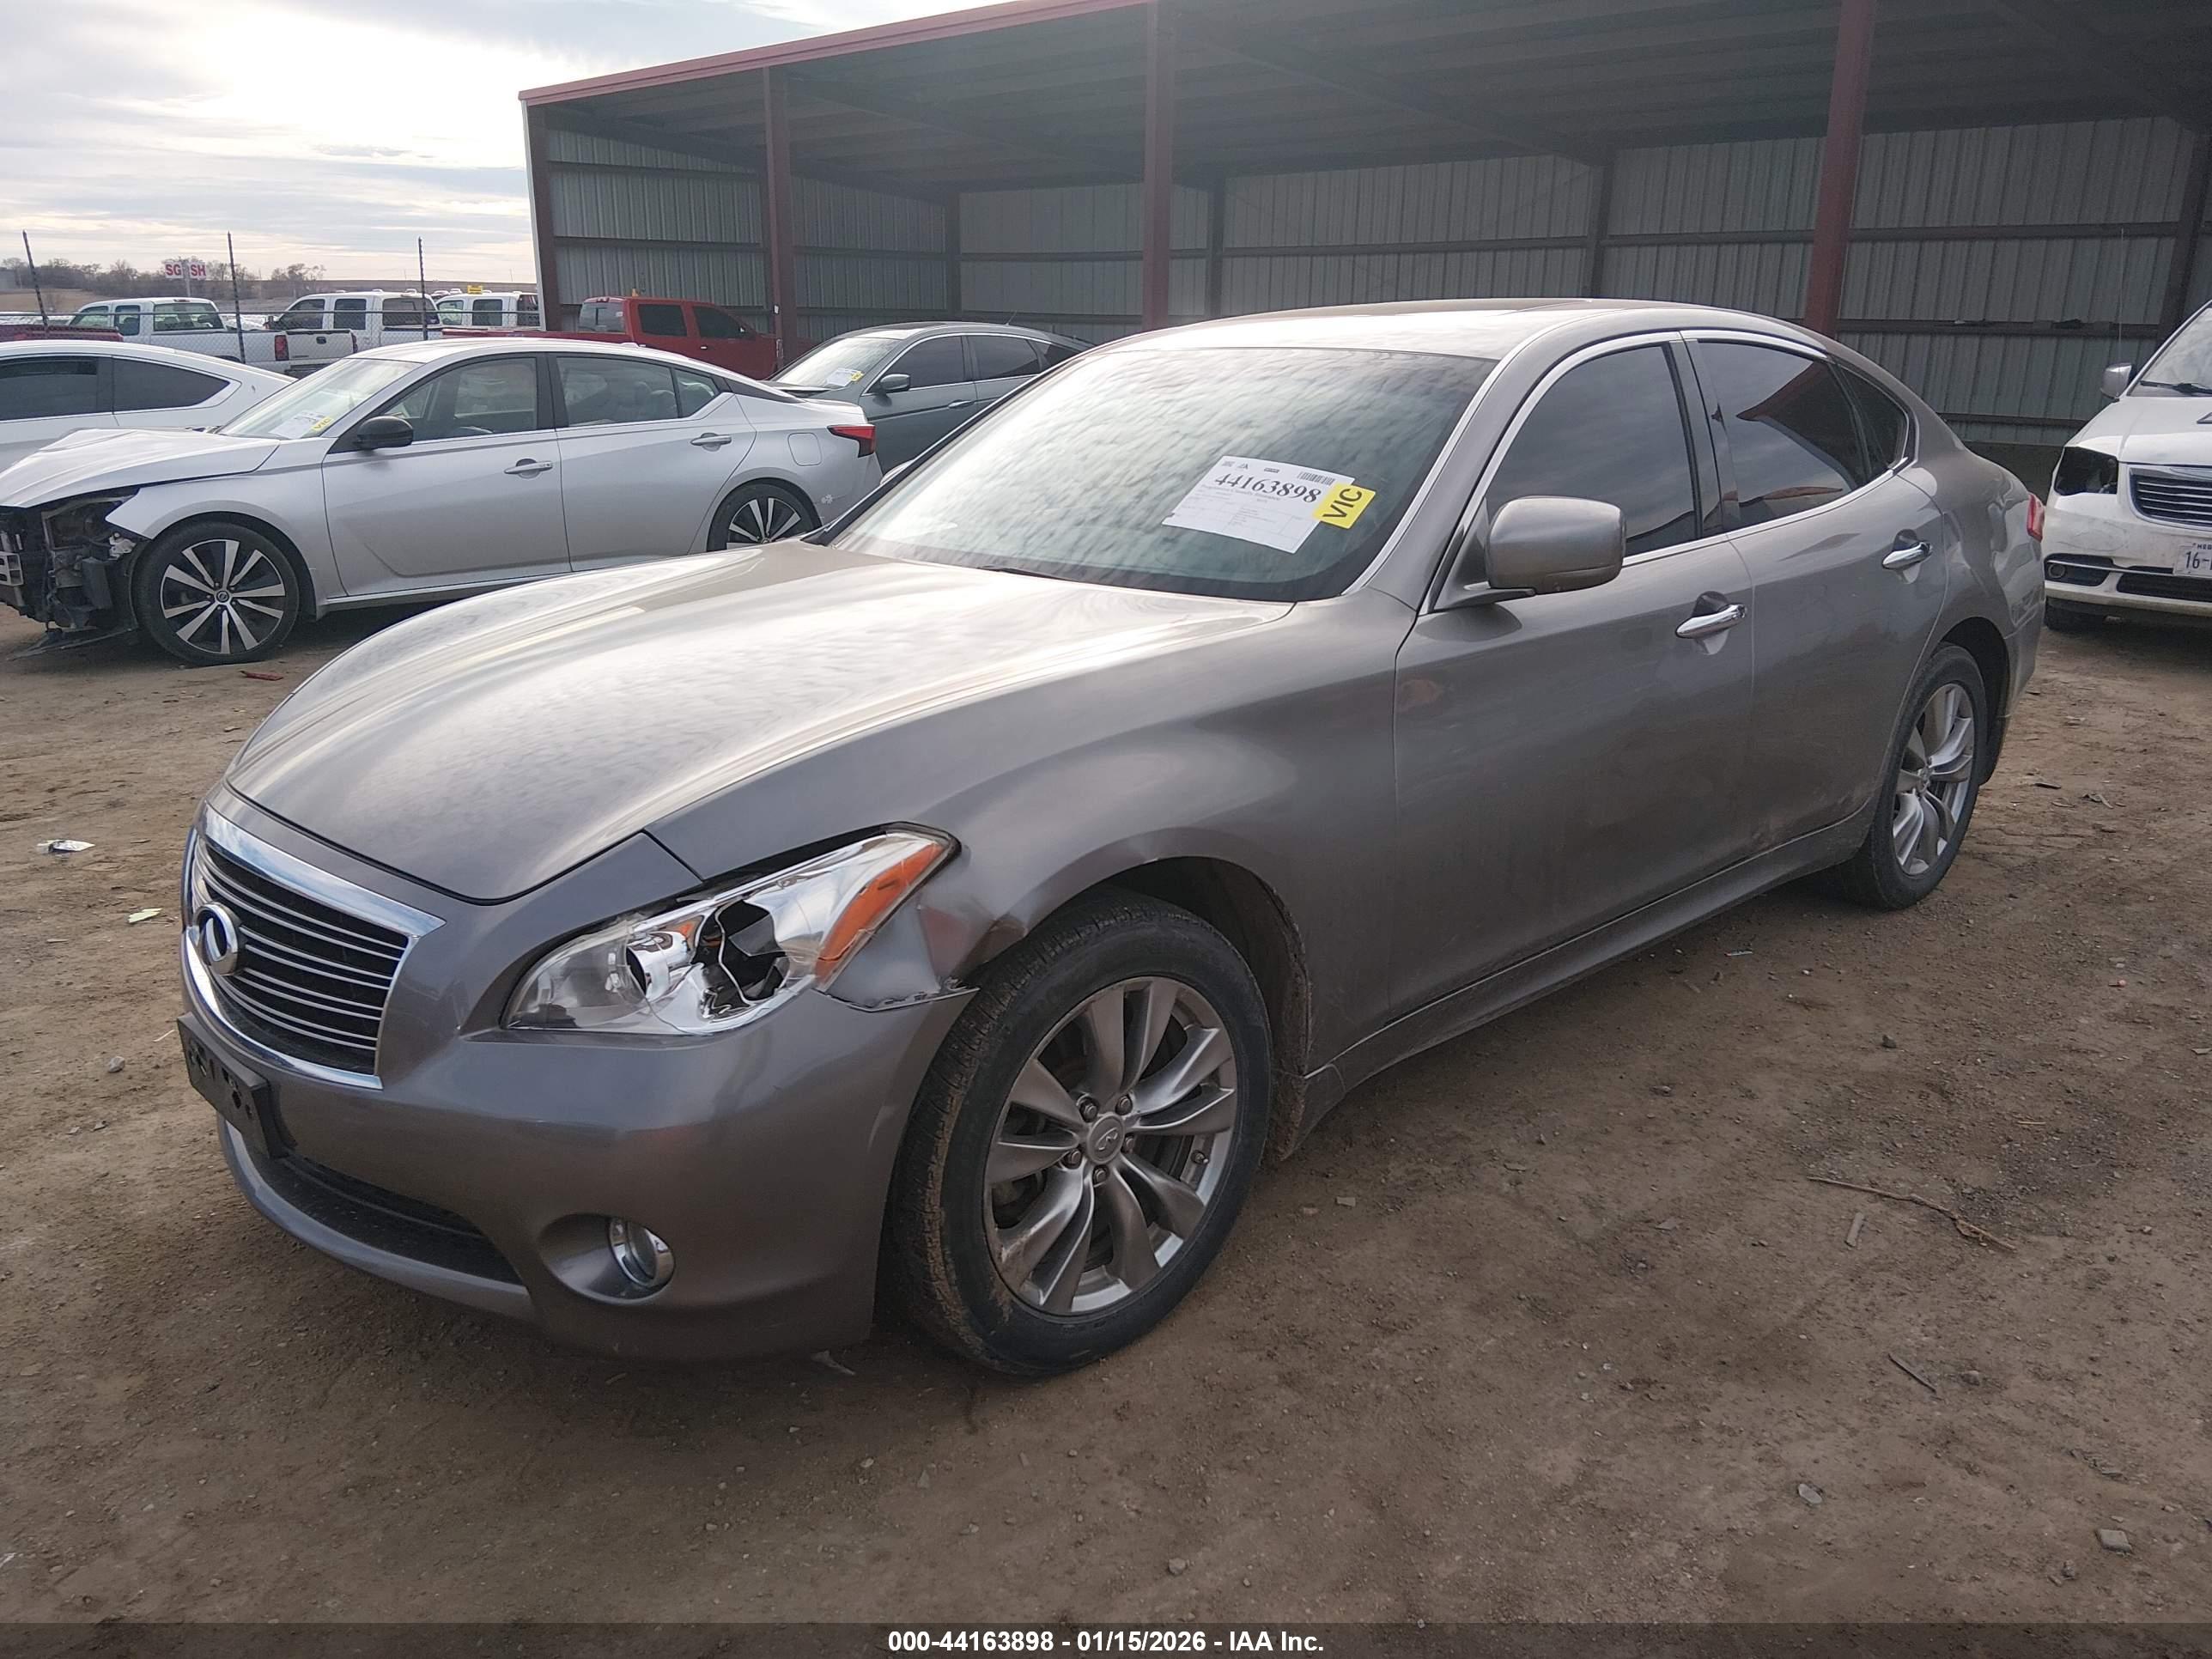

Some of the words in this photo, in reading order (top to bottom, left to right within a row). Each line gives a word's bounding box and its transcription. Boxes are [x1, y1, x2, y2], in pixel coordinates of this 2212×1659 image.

[1215, 473, 1322, 503] 44163898
[1322, 488, 1363, 519] VIC
[2186, 550, 2212, 571] 16-
